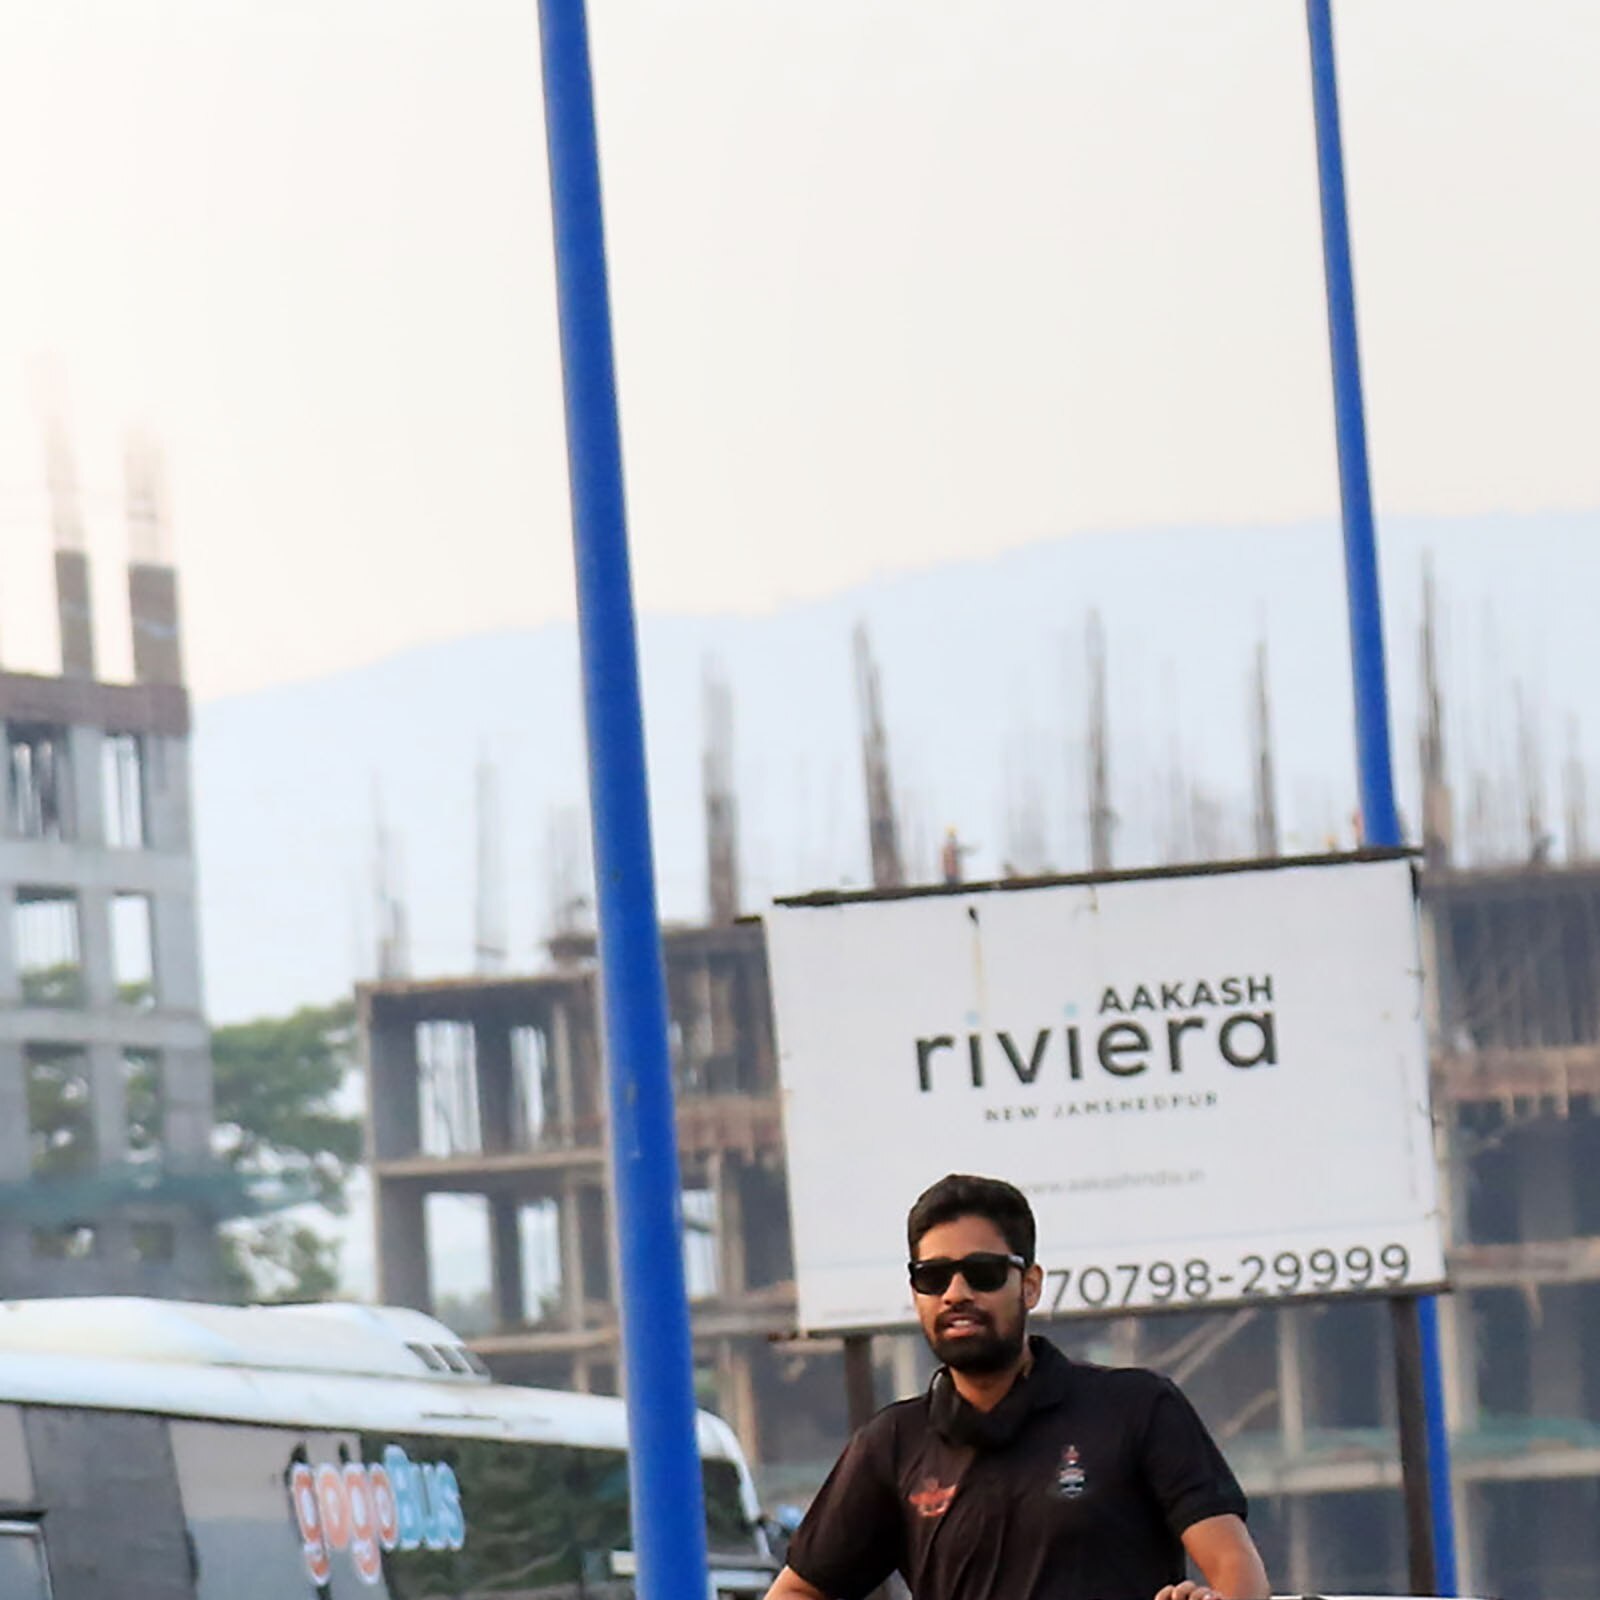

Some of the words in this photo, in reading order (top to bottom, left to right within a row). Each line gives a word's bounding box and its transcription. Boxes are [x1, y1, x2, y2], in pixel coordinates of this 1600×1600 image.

[1099, 974, 1275, 1015] AAKASH
[914, 1000, 1278, 1093] riviera
[985, 1107, 1039, 1123] NEW
[1046, 1243, 1412, 1317] 70798-29999
